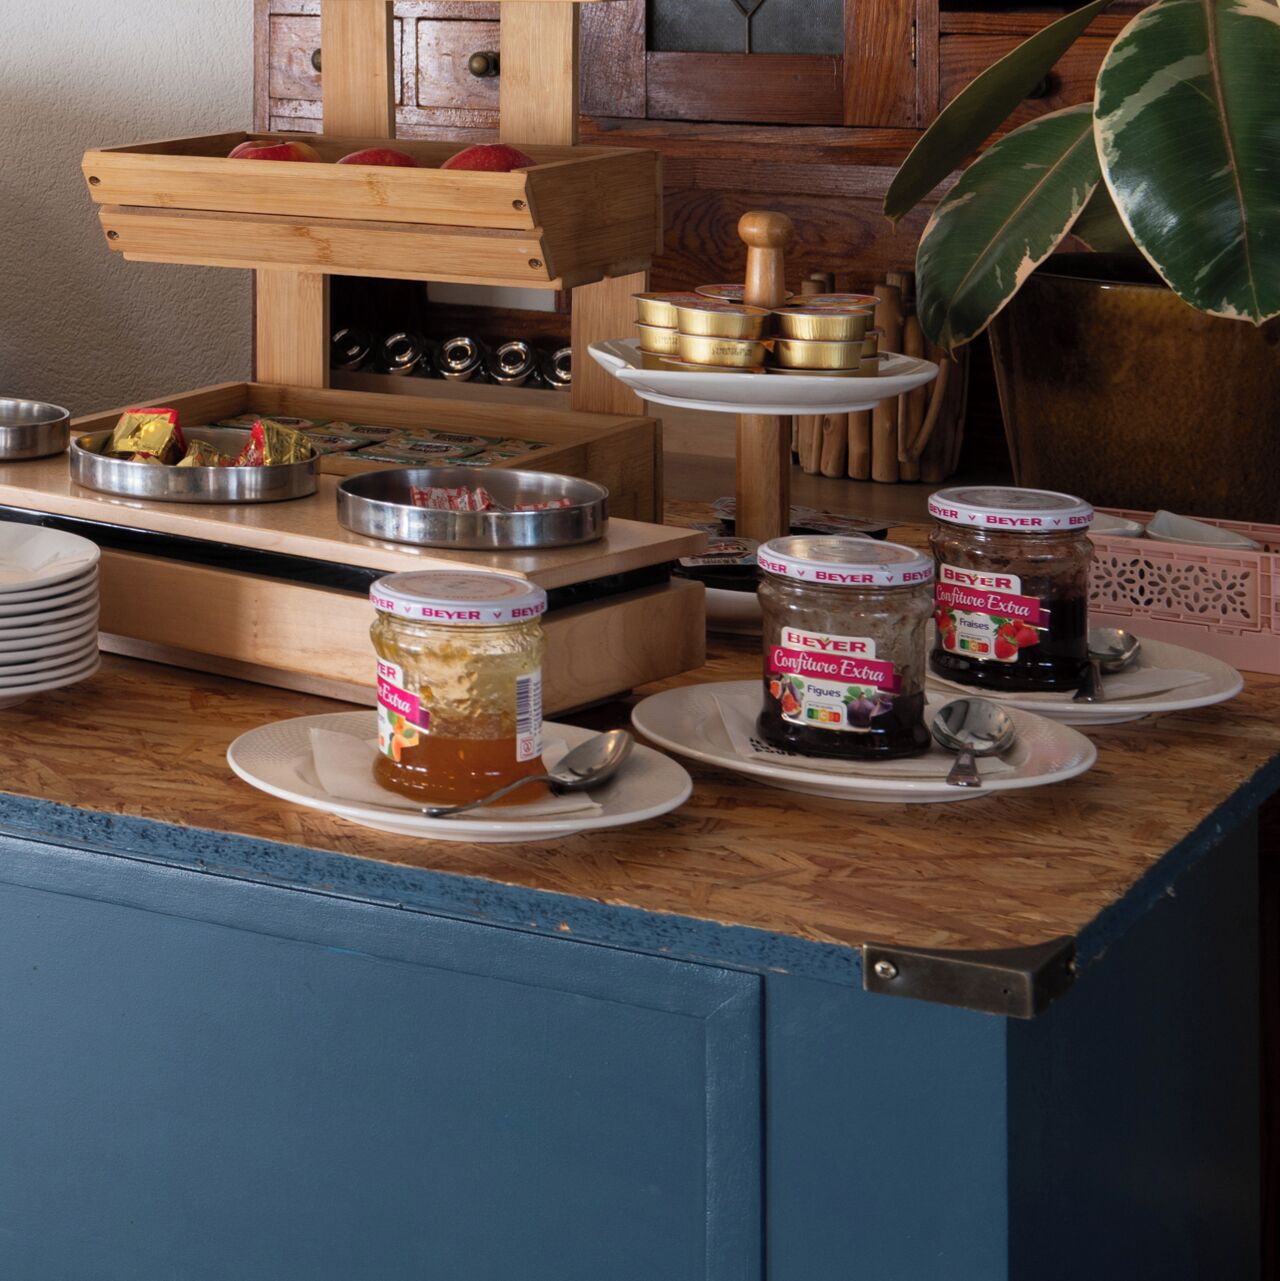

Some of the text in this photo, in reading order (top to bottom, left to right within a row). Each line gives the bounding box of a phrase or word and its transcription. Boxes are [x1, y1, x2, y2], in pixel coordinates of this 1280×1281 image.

[986, 515, 1042, 526] BEYER
[816, 572, 874, 583] BEYER
[944, 568, 1012, 589] BEYER
[936, 584, 1031, 617] Confiture Extra
[422, 607, 481, 620] BEYER
[959, 617, 990, 630] Fraises
[788, 632, 867, 652] BEYER
[774, 650, 885, 682] Confiture Extra
[808, 685, 841, 698] Figues
